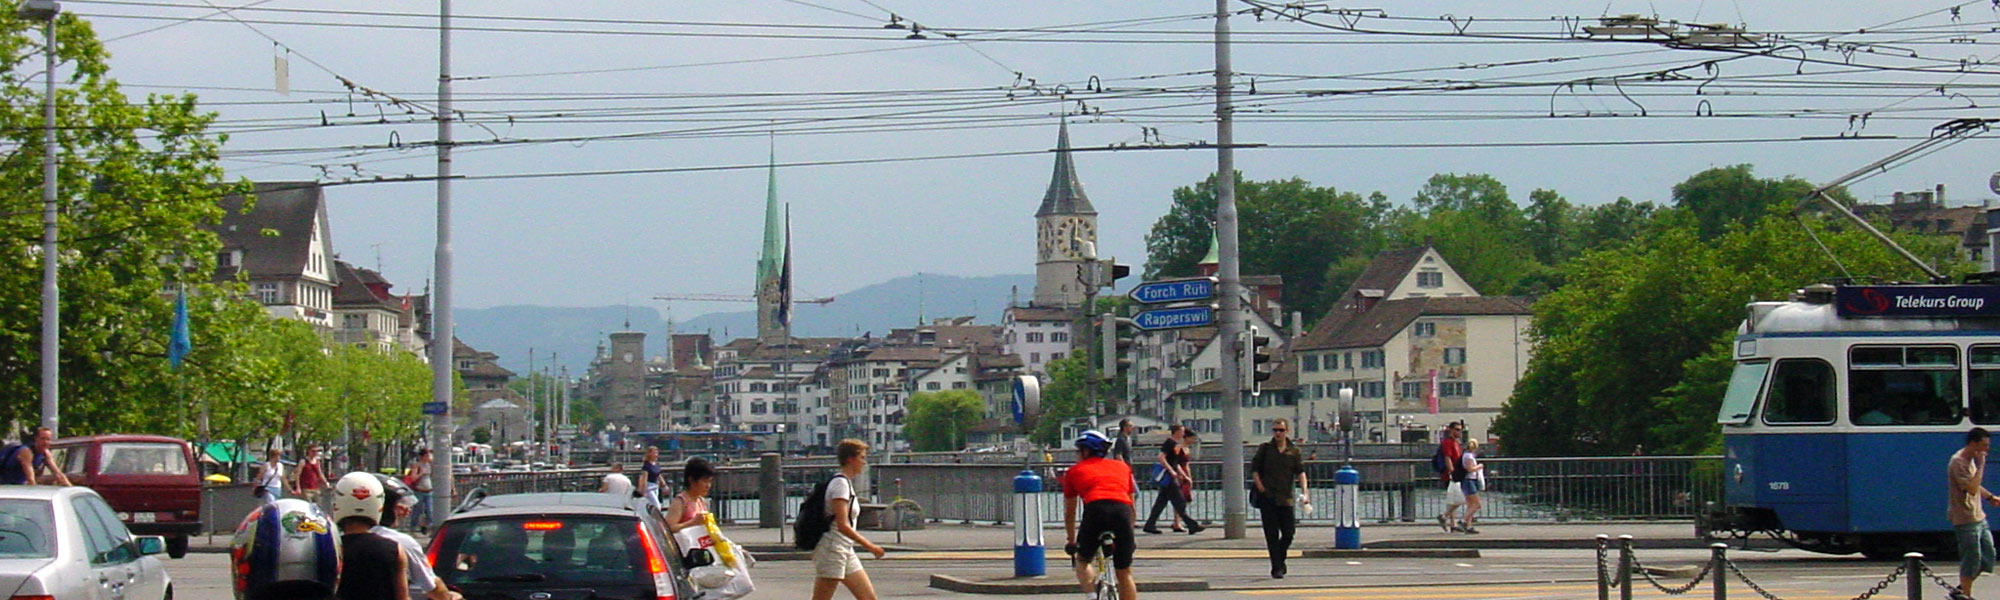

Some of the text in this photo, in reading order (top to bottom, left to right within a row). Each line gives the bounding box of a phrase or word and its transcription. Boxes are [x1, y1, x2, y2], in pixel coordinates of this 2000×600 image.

[1144, 286, 1176, 299] Forch
[1895, 295, 1984, 310] Telekurs Group
[1144, 309, 1209, 327] Rapperswil
